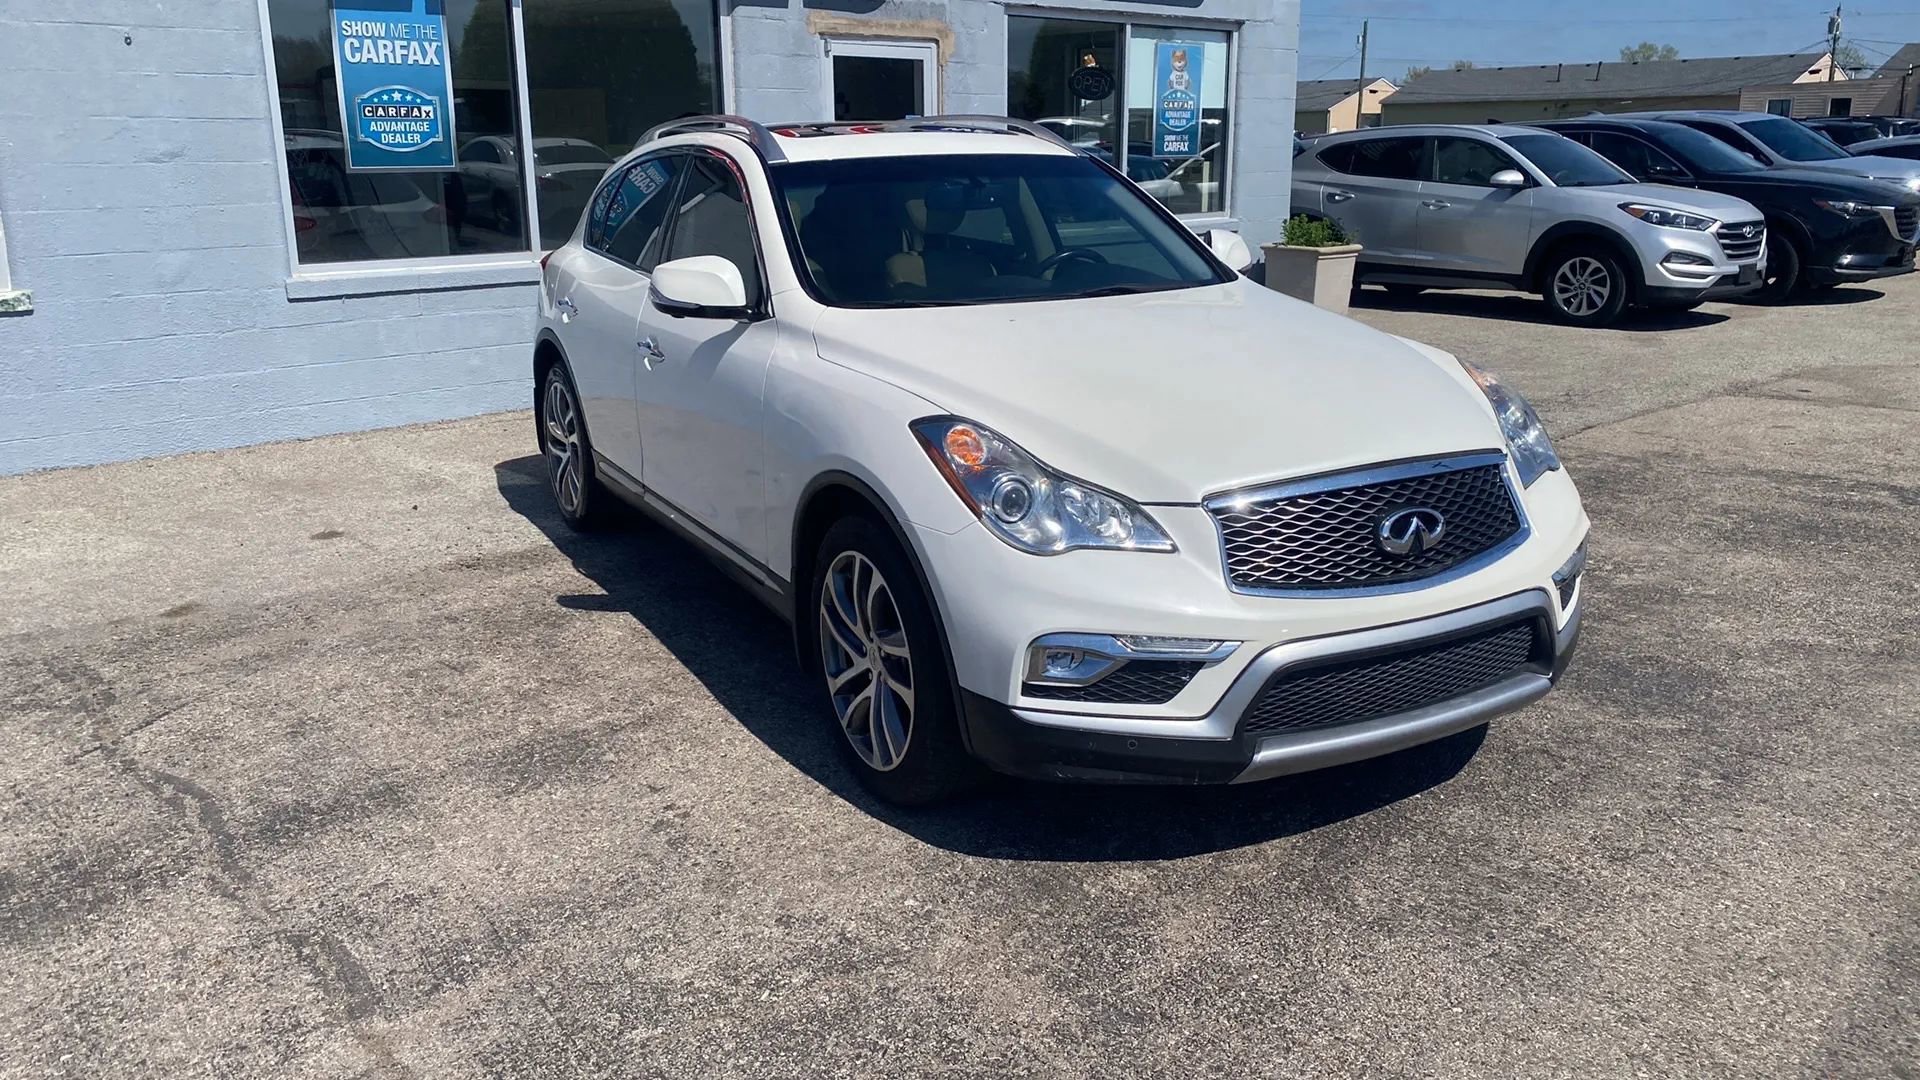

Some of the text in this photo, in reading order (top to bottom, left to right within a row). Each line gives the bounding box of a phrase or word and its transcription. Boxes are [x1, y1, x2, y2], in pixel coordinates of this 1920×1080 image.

[341, 20, 437, 40] SHOW ME THE
[344, 38, 441, 66] CARFAX
[1073, 75, 1110, 92] OPEN
[362, 105, 434, 119] CARFAX
[370, 121, 430, 132] ADVANTAGE
[381, 133, 421, 144] DEALER
[1164, 142, 1189, 151] CARFAX
